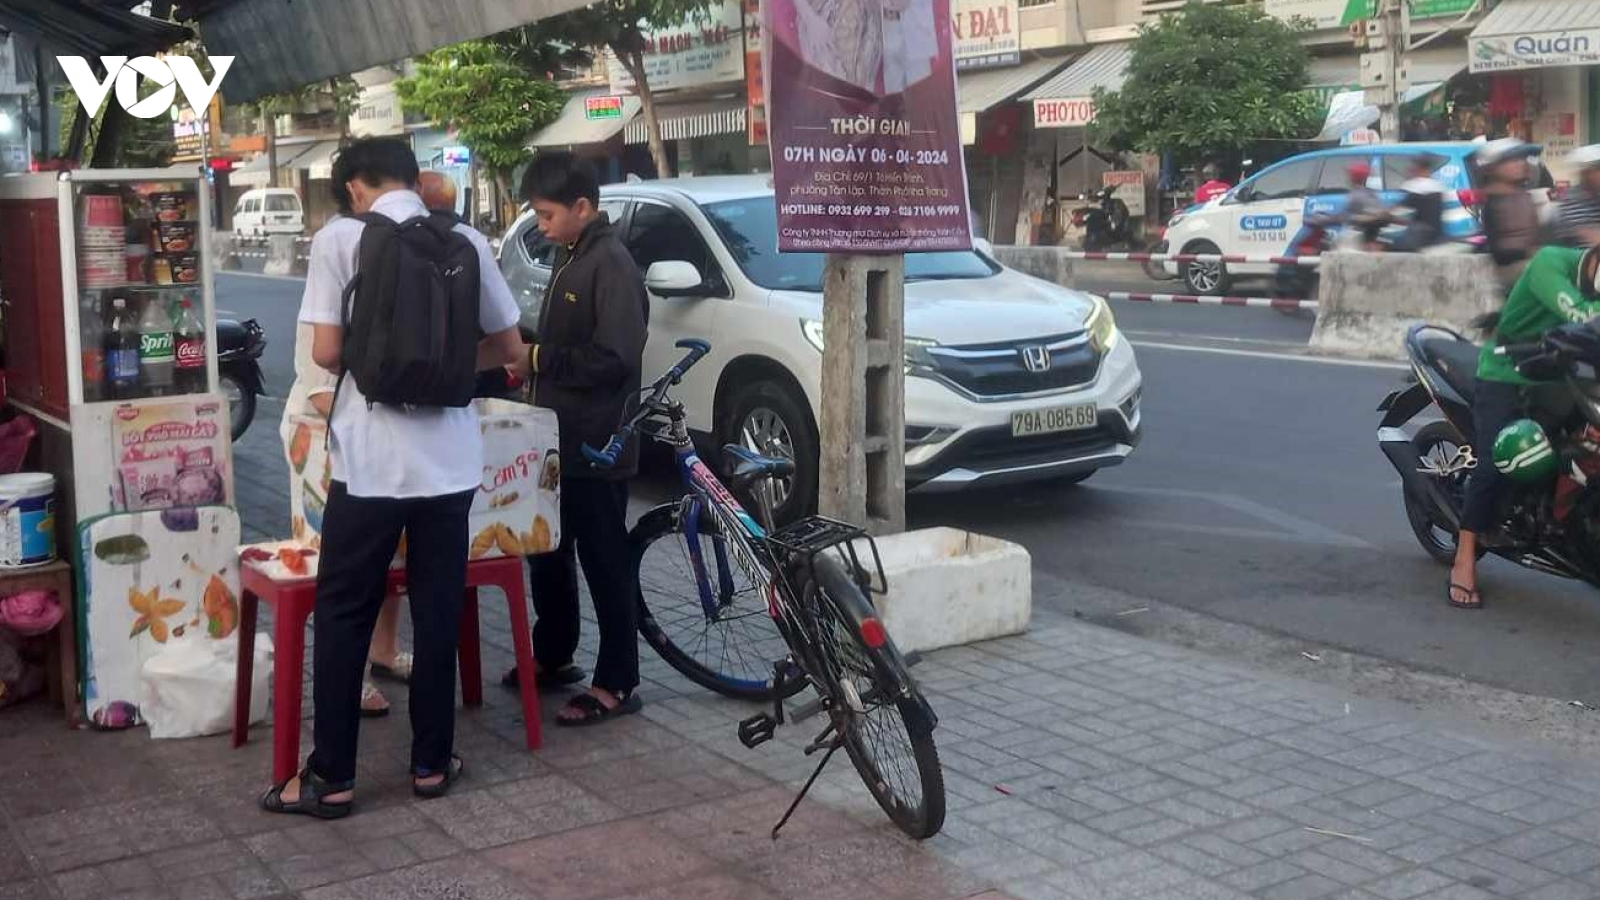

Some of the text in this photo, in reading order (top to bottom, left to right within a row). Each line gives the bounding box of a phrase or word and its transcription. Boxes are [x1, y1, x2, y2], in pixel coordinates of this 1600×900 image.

[1514, 31, 1589, 55] Quán
[830, 115, 875, 135] THỜI
[784, 146, 814, 162] 07H
[819, 143, 867, 163] NGÀY
[871, 150, 886, 163] 06
[916, 151, 948, 164] 2024
[780, 203, 825, 216] HOTLINE:
[828, 205, 852, 216] 0932
[853, 205, 872, 217] 699
[937, 205, 960, 217] 9999
[141, 332, 174, 353] Sprit
